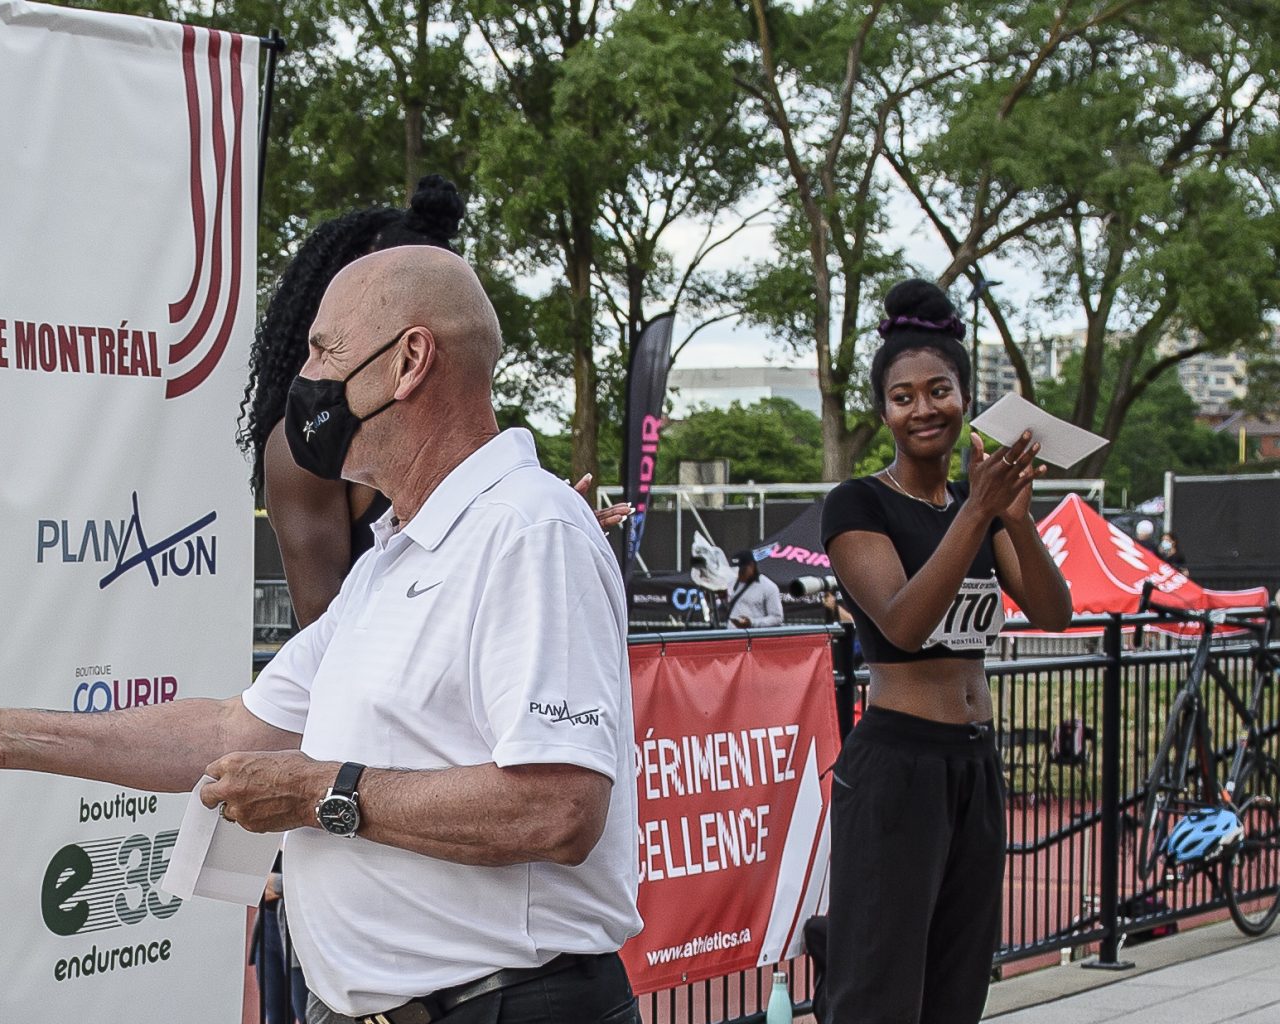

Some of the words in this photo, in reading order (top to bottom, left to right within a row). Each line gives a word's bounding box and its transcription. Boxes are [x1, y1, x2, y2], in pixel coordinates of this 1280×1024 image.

[14, 320, 162, 378] MONTRÉAL
[75, 665, 111, 678] BOUTIQUE
[634, 724, 799, 800] PÉRIMENTEZ
[79, 792, 158, 823] boutique
[638, 805, 770, 884] CELLENCE
[54, 939, 171, 981] endurance
[646, 927, 751, 966] www.athletics.ca
